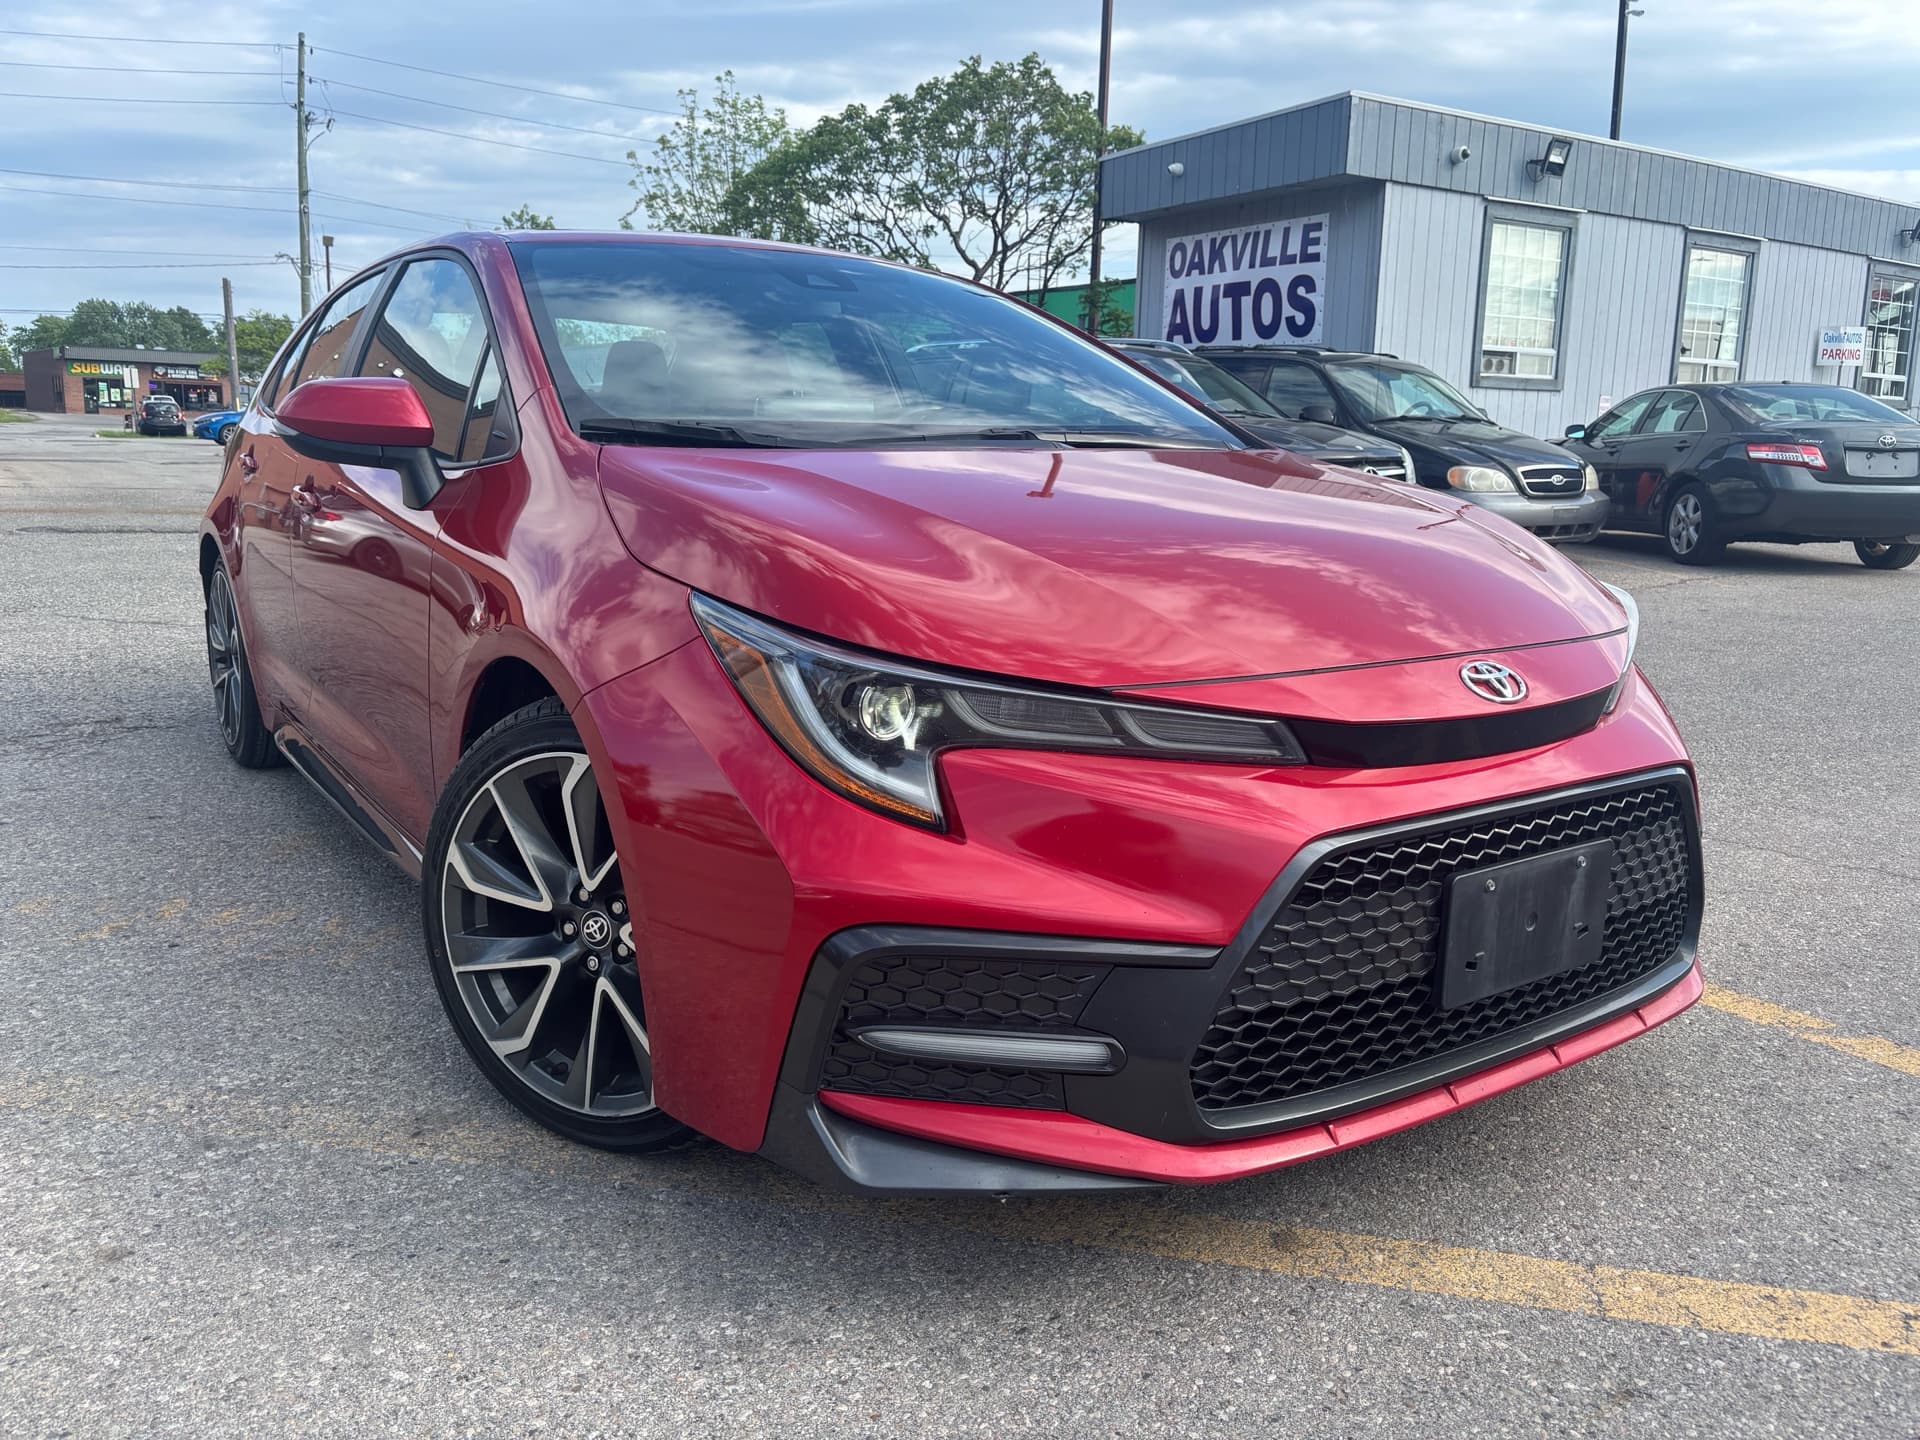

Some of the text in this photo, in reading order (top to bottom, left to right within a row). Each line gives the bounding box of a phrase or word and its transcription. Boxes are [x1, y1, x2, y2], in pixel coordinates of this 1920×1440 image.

[1169, 222, 1323, 279] OAKVILLE
[1166, 274, 1317, 344] AUTOS
[1821, 348, 1861, 360] PARKING
[1846, 333, 1862, 344] AUTOS
